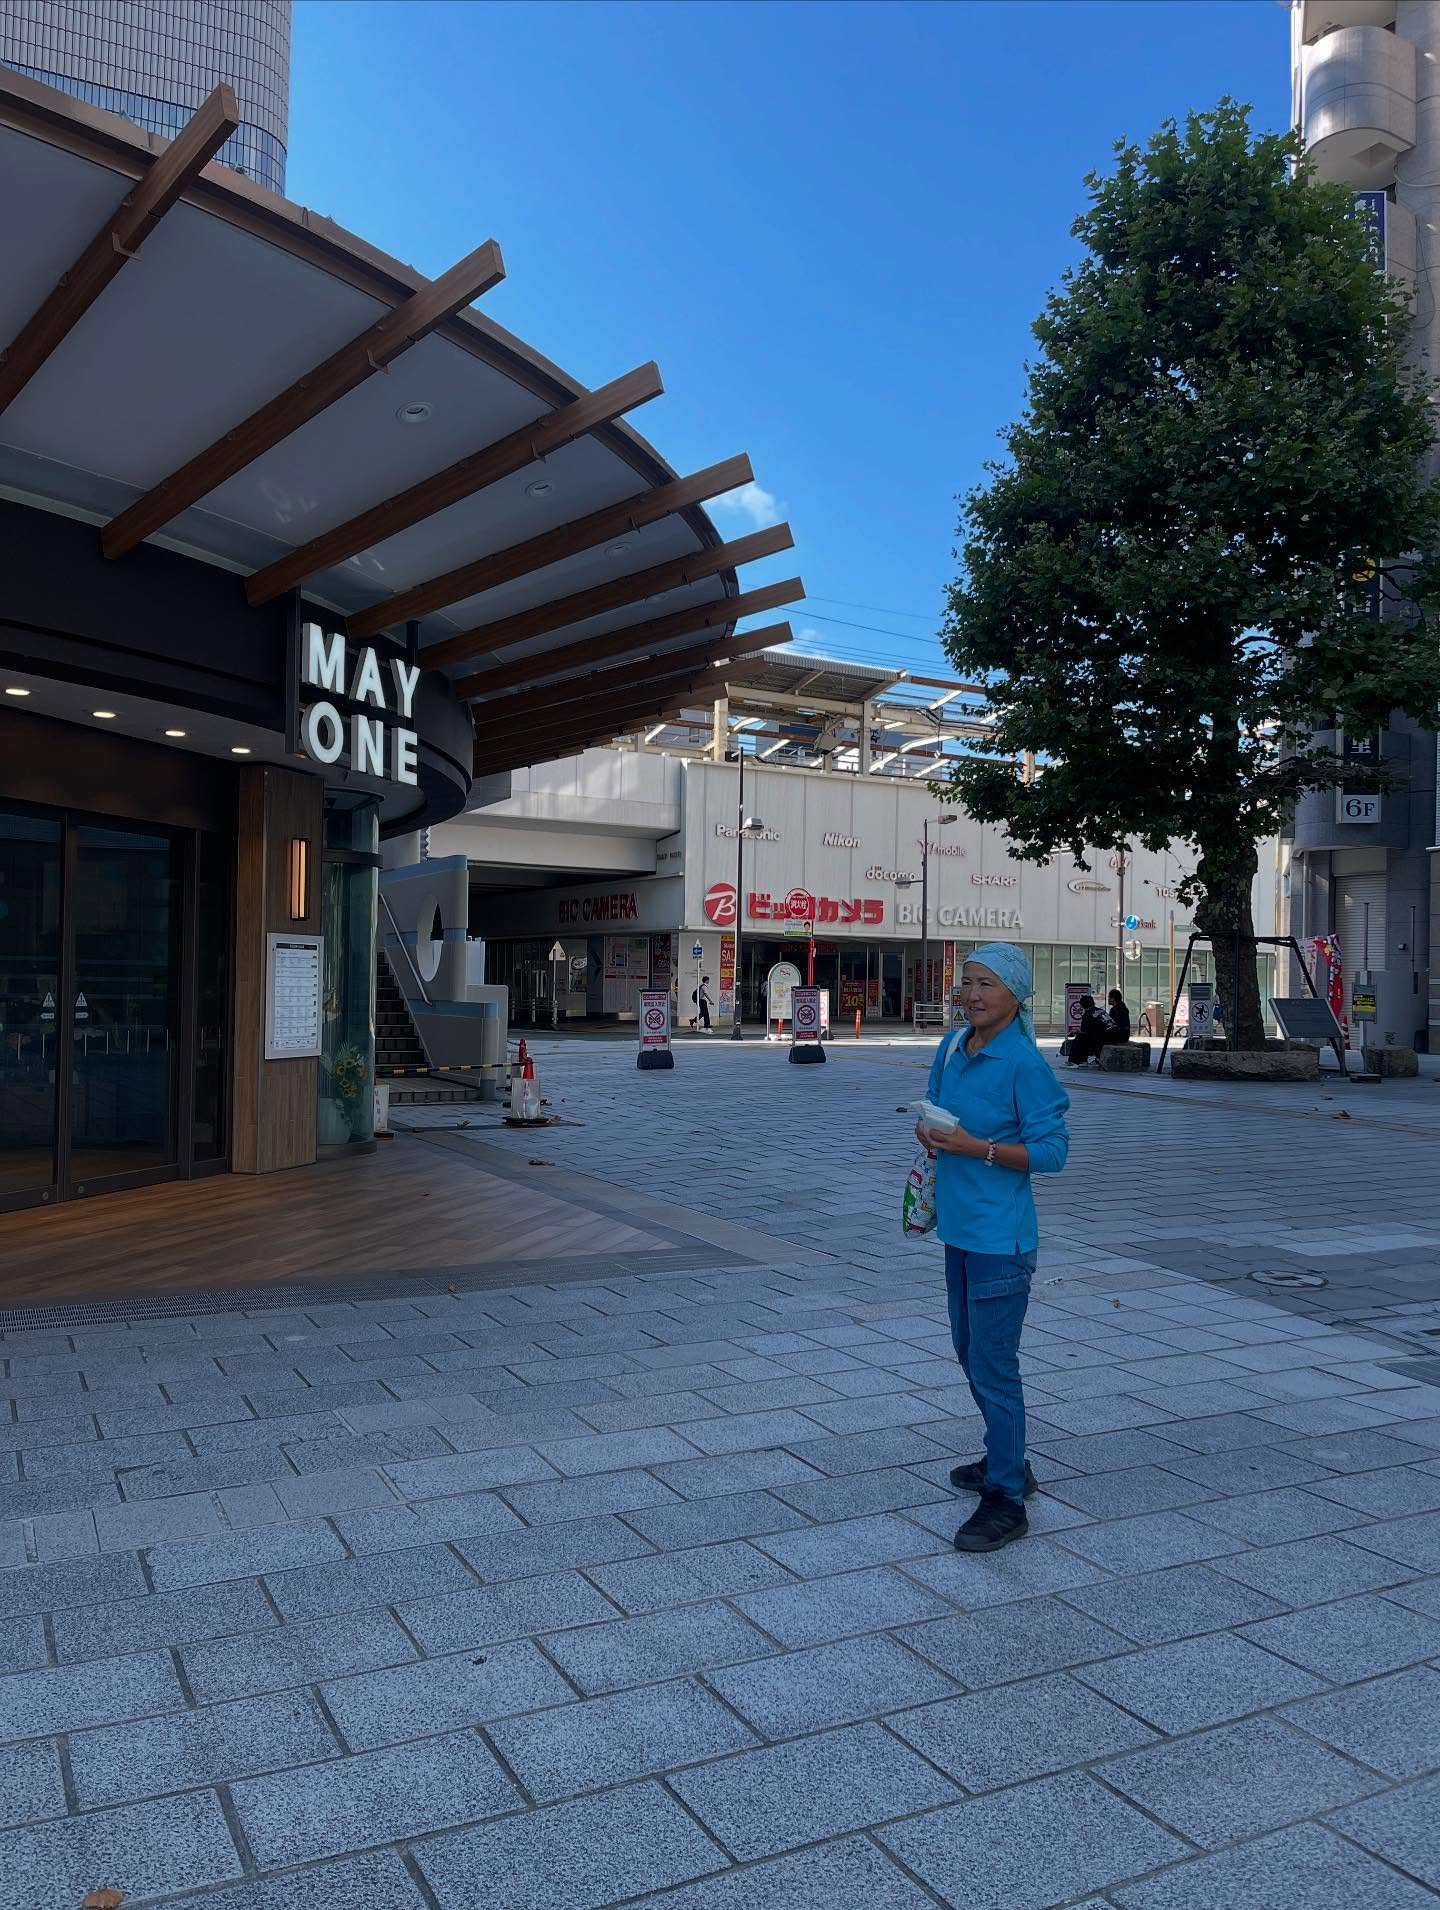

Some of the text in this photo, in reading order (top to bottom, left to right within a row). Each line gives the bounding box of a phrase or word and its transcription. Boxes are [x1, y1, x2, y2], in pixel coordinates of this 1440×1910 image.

[302, 622, 421, 718] MAY
[301, 701, 418, 786] ONE
[1346, 799, 1375, 817] 6F
[822, 832, 861, 848] Nikon
[866, 865, 916, 881] docomo
[971, 874, 1017, 887] SHARP
[583, 893, 638, 921] CAMERA
[938, 905, 1025, 929] CAMERA
[721, 949, 735, 962] SAL
